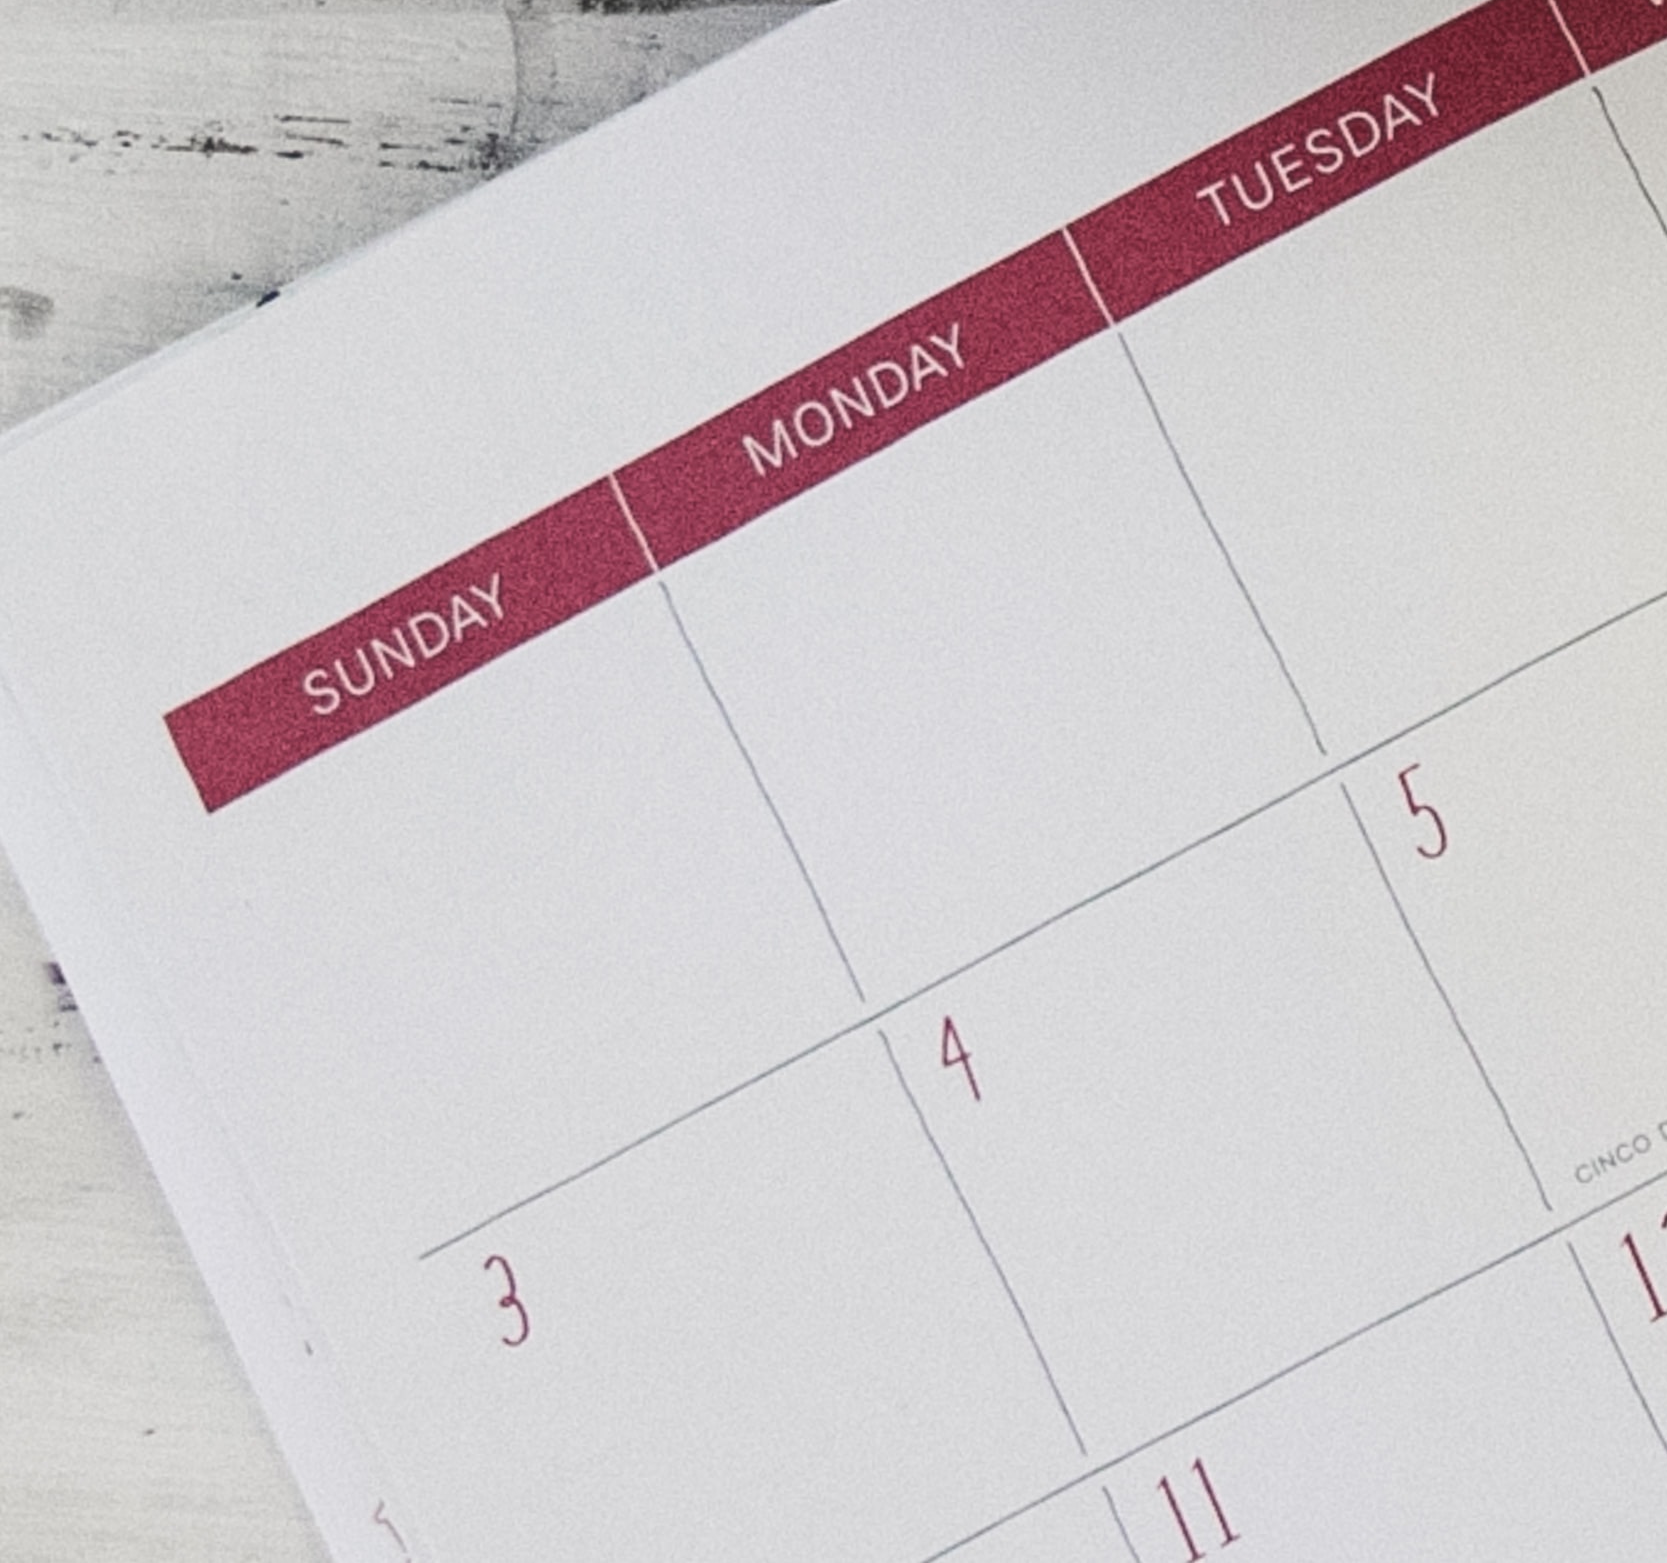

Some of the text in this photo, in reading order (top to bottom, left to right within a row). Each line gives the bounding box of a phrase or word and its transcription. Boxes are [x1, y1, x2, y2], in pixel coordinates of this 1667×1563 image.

[302, 572, 507, 716] SUNDAY
[741, 323, 968, 476] MONDAY
[1196, 73, 1441, 228] TUESDAY
[1397, 762, 1448, 860] 5
[941, 1015, 982, 1102] 4
[1575, 1134, 1651, 1184] CINCO
[482, 1254, 531, 1347] 3
[1156, 1457, 1241, 1563] 11
